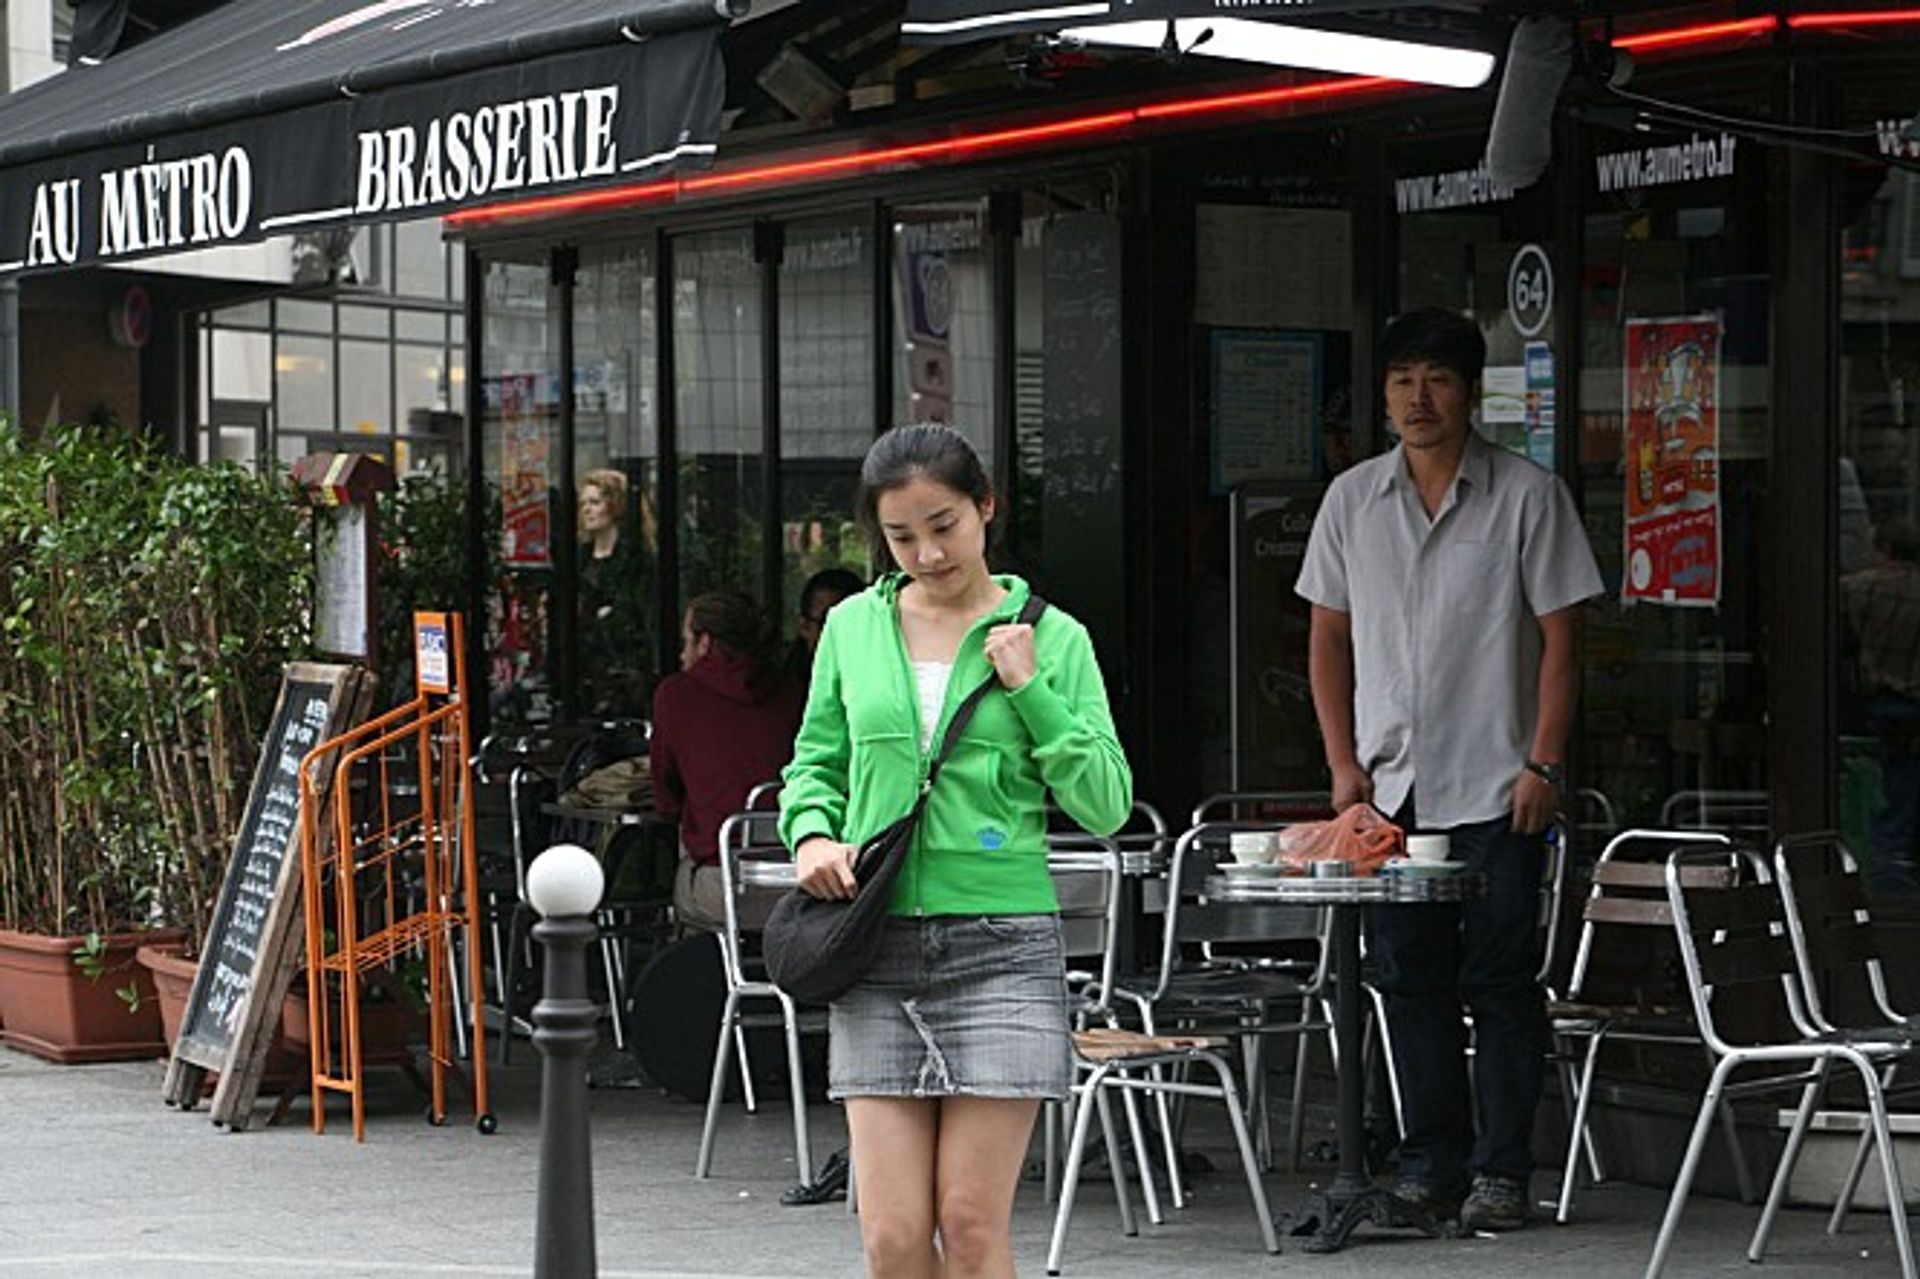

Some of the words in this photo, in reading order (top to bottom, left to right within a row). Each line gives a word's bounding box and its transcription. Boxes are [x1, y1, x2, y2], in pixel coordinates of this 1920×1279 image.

[355, 85, 618, 213] BRASSERIE
[1596, 132, 1736, 192] www.aumetro.fr
[26, 178, 81, 266] AU
[98, 144, 252, 256] MÉTRO
[1516, 267, 1545, 311] 64
